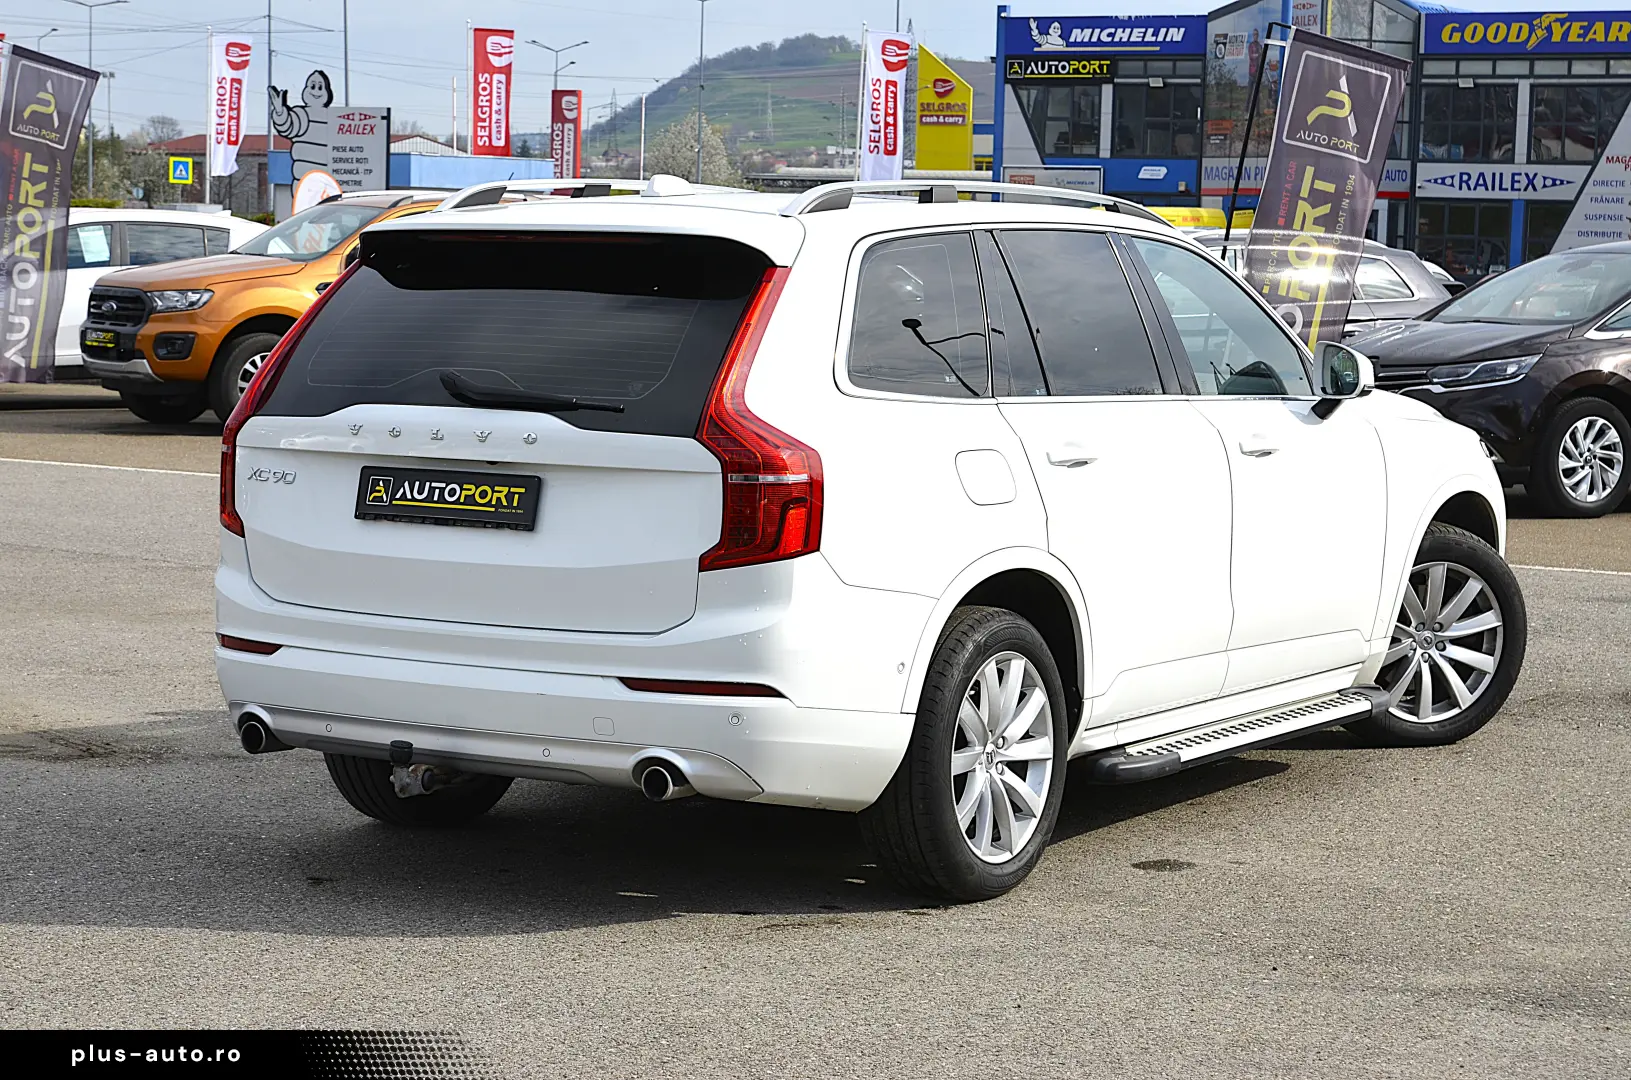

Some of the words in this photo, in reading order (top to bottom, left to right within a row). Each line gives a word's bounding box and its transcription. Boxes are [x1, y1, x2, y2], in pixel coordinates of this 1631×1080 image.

[1068, 27, 1186, 42] MICHELIN
[1026, 61, 1111, 74] AUTOPORT
[231, 82, 242, 109] carry
[494, 79, 504, 106] carry
[887, 85, 897, 114] carry
[216, 76, 227, 145] SELGROS
[477, 73, 490, 147] SELGROS
[494, 108, 502, 116] &
[868, 77, 882, 155] SELGROS
[919, 102, 967, 112] SELGROS
[229, 117, 238, 141] cash
[337, 123, 377, 135] RAILEX
[494, 117, 502, 141] cash
[886, 117, 895, 125] &
[922, 115, 938, 123] cash
[945, 116, 963, 124] carry
[17, 123, 39, 135] AUTO
[40, 129, 60, 141] PORT
[885, 126, 895, 150] cash
[1296, 129, 1328, 145] AUTO
[1330, 136, 1360, 153] PORT
[332, 145, 348, 153] PIESE
[348, 145, 364, 153] AUTO
[553, 122, 563, 179] SELGROS
[54, 177, 60, 186] IN
[1203, 166, 1251, 181] MAGAN
[1344, 174, 1356, 195] 1994
[1384, 169, 1408, 182] AUTO
[1458, 171, 1539, 193] RAILEX
[1592, 180, 1626, 189] DIRECȚIE
[1280, 192, 1291, 217] RENT
[1286, 160, 1298, 181] CAR
[4, 203, 13, 226] AUTO
[50, 187, 61, 220] FONDAT
[1341, 198, 1350, 209] IN
[1584, 213, 1624, 222] SUSPENSIE
[2, 227, 11, 249] PARC
[3, 151, 49, 368] AUTOPORT
[348, 423, 538, 444] VOLVO
[394, 480, 526, 507] AUTOPORT
